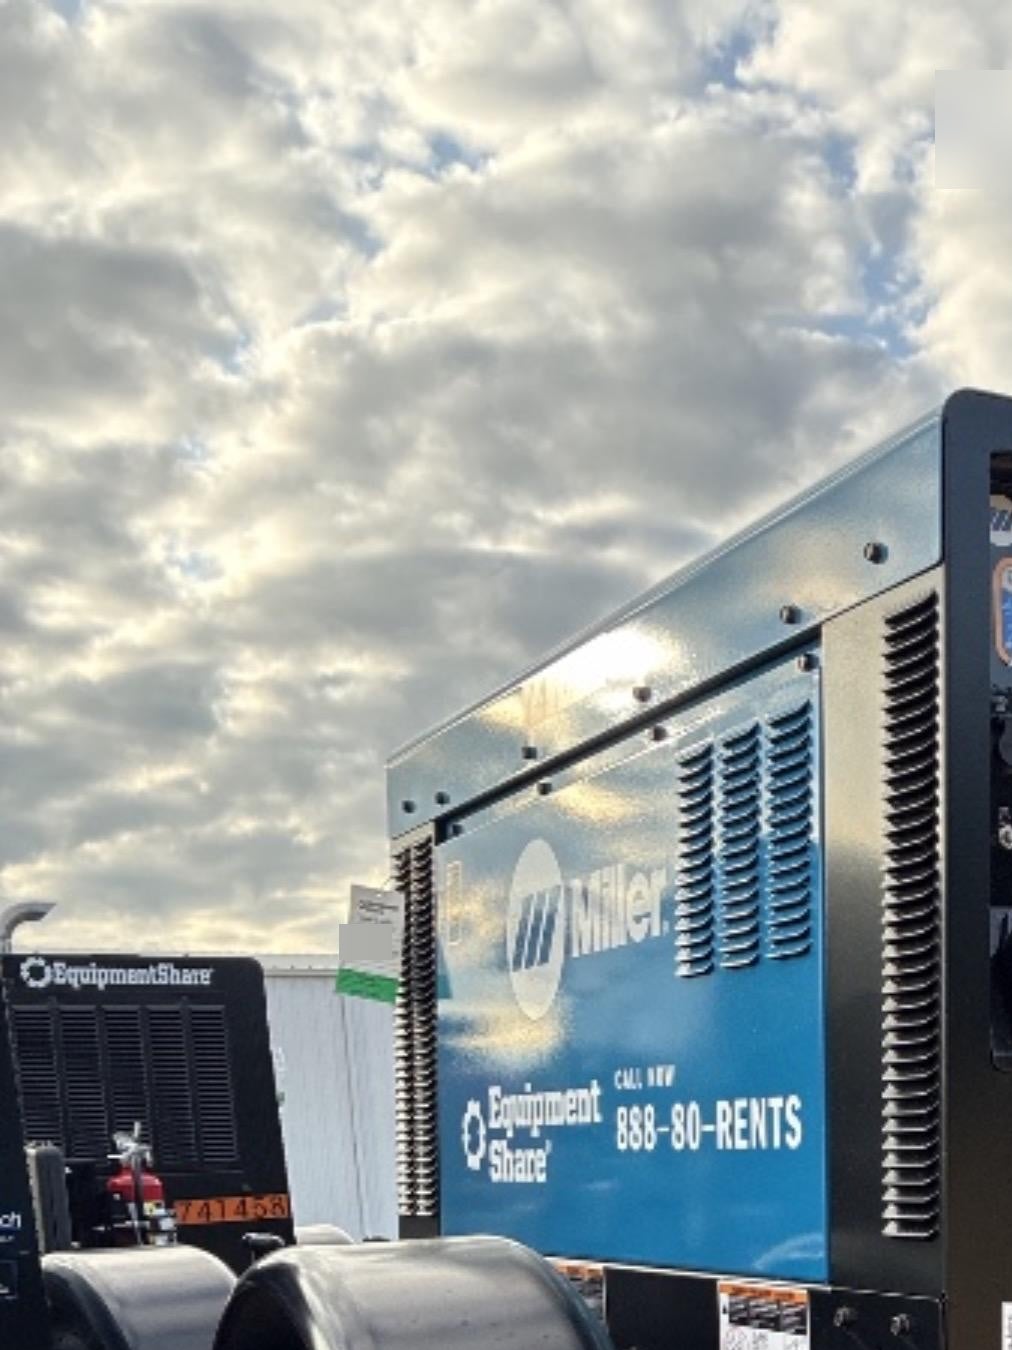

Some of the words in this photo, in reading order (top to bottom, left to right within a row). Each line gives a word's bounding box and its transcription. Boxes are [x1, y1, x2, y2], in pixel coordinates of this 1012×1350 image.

[569, 863, 670, 958] Miller
[52, 961, 213, 990] EquipmentShare
[488, 1079, 602, 1138] Equipment
[616, 1095, 802, 1151] 888-80-RENTS
[488, 1139, 549, 1183] Share
